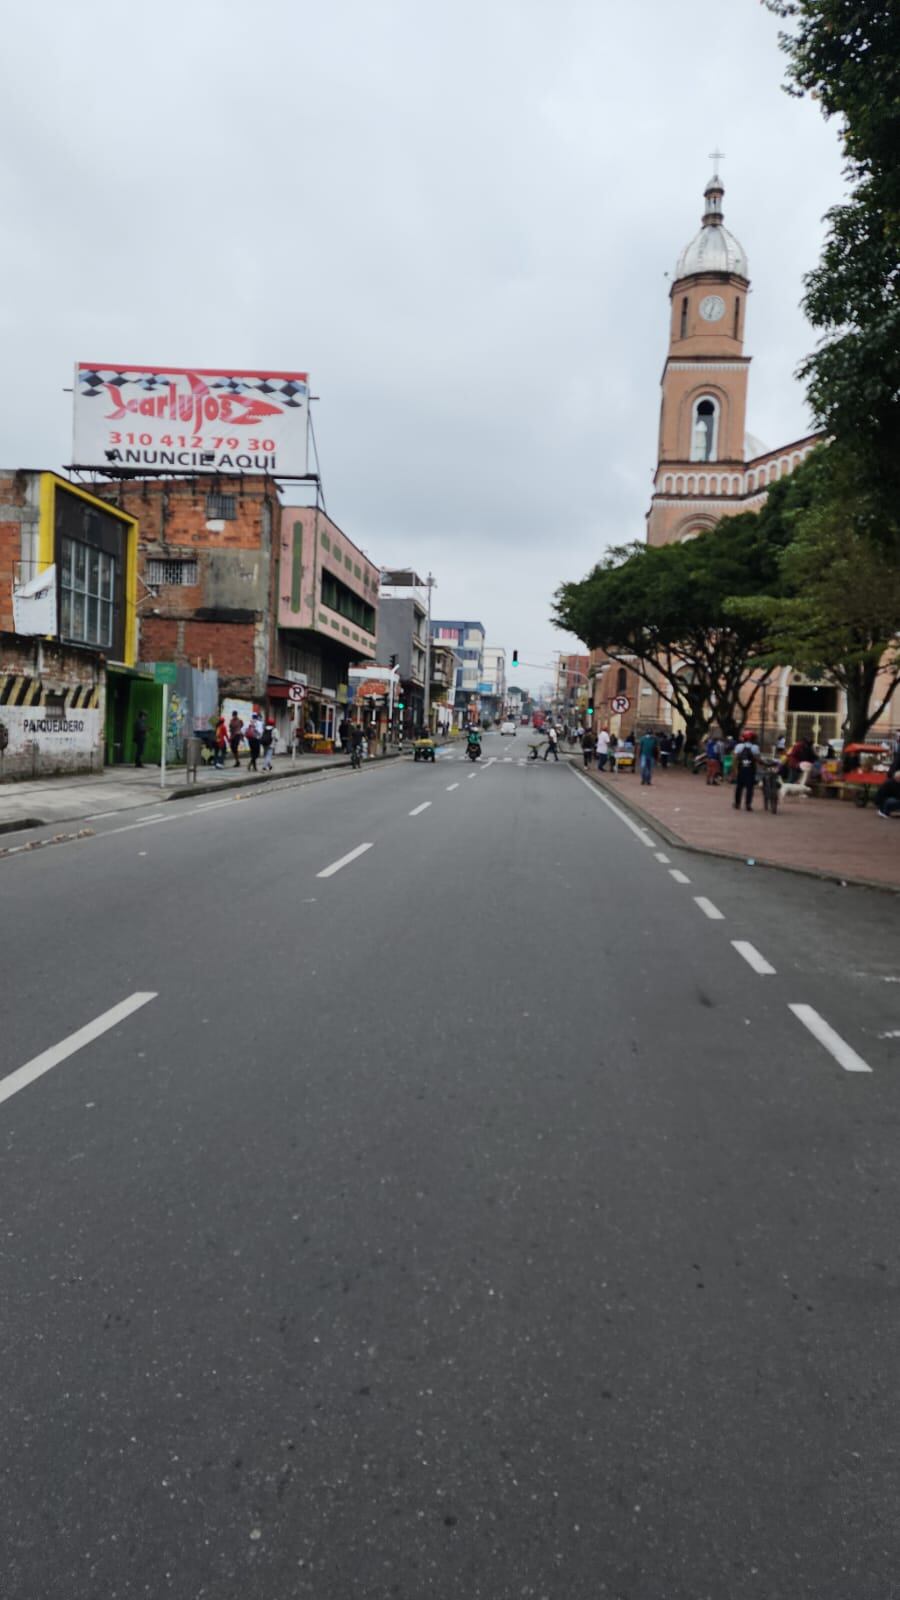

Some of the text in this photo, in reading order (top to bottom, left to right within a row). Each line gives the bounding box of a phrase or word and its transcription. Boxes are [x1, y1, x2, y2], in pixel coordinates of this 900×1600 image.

[110, 432, 275, 452] 310 412 79 30
[110, 448, 212, 466] ANUNCIE
[23, 719, 84, 733] PARQUEADERO
